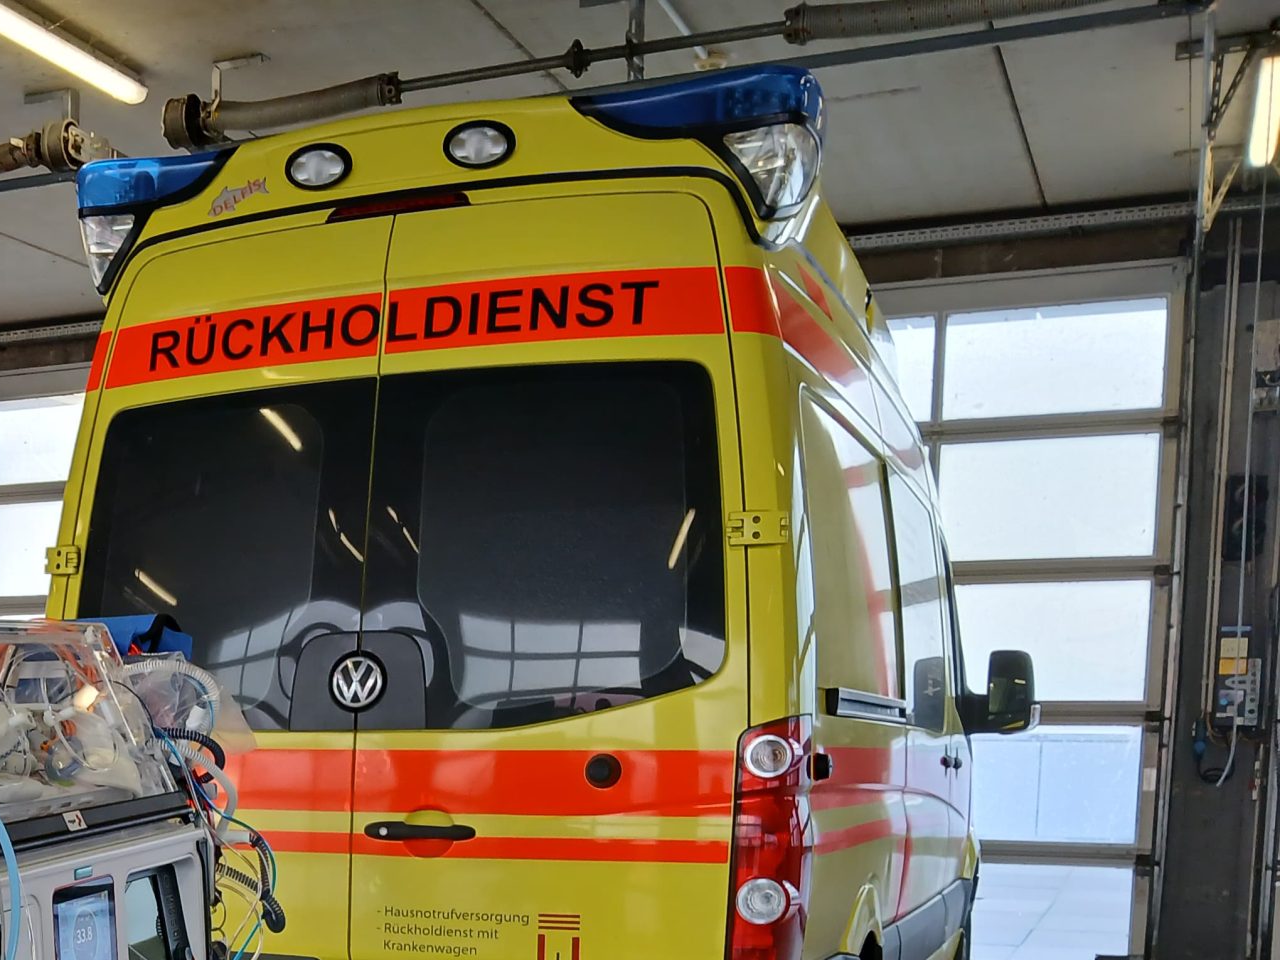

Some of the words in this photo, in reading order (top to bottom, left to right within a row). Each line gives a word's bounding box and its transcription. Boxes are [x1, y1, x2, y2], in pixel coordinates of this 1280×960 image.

[213, 179, 261, 216] DELFIS
[149, 280, 659, 371] RÜCKHOLDIENST
[384, 905, 530, 926] Hausnotrufversorgung
[76, 926, 93, 944] 33.8
[384, 922, 474, 939] Rückholdienst
[477, 928, 499, 940] mit
[383, 940, 478, 958] Krankenwagen
